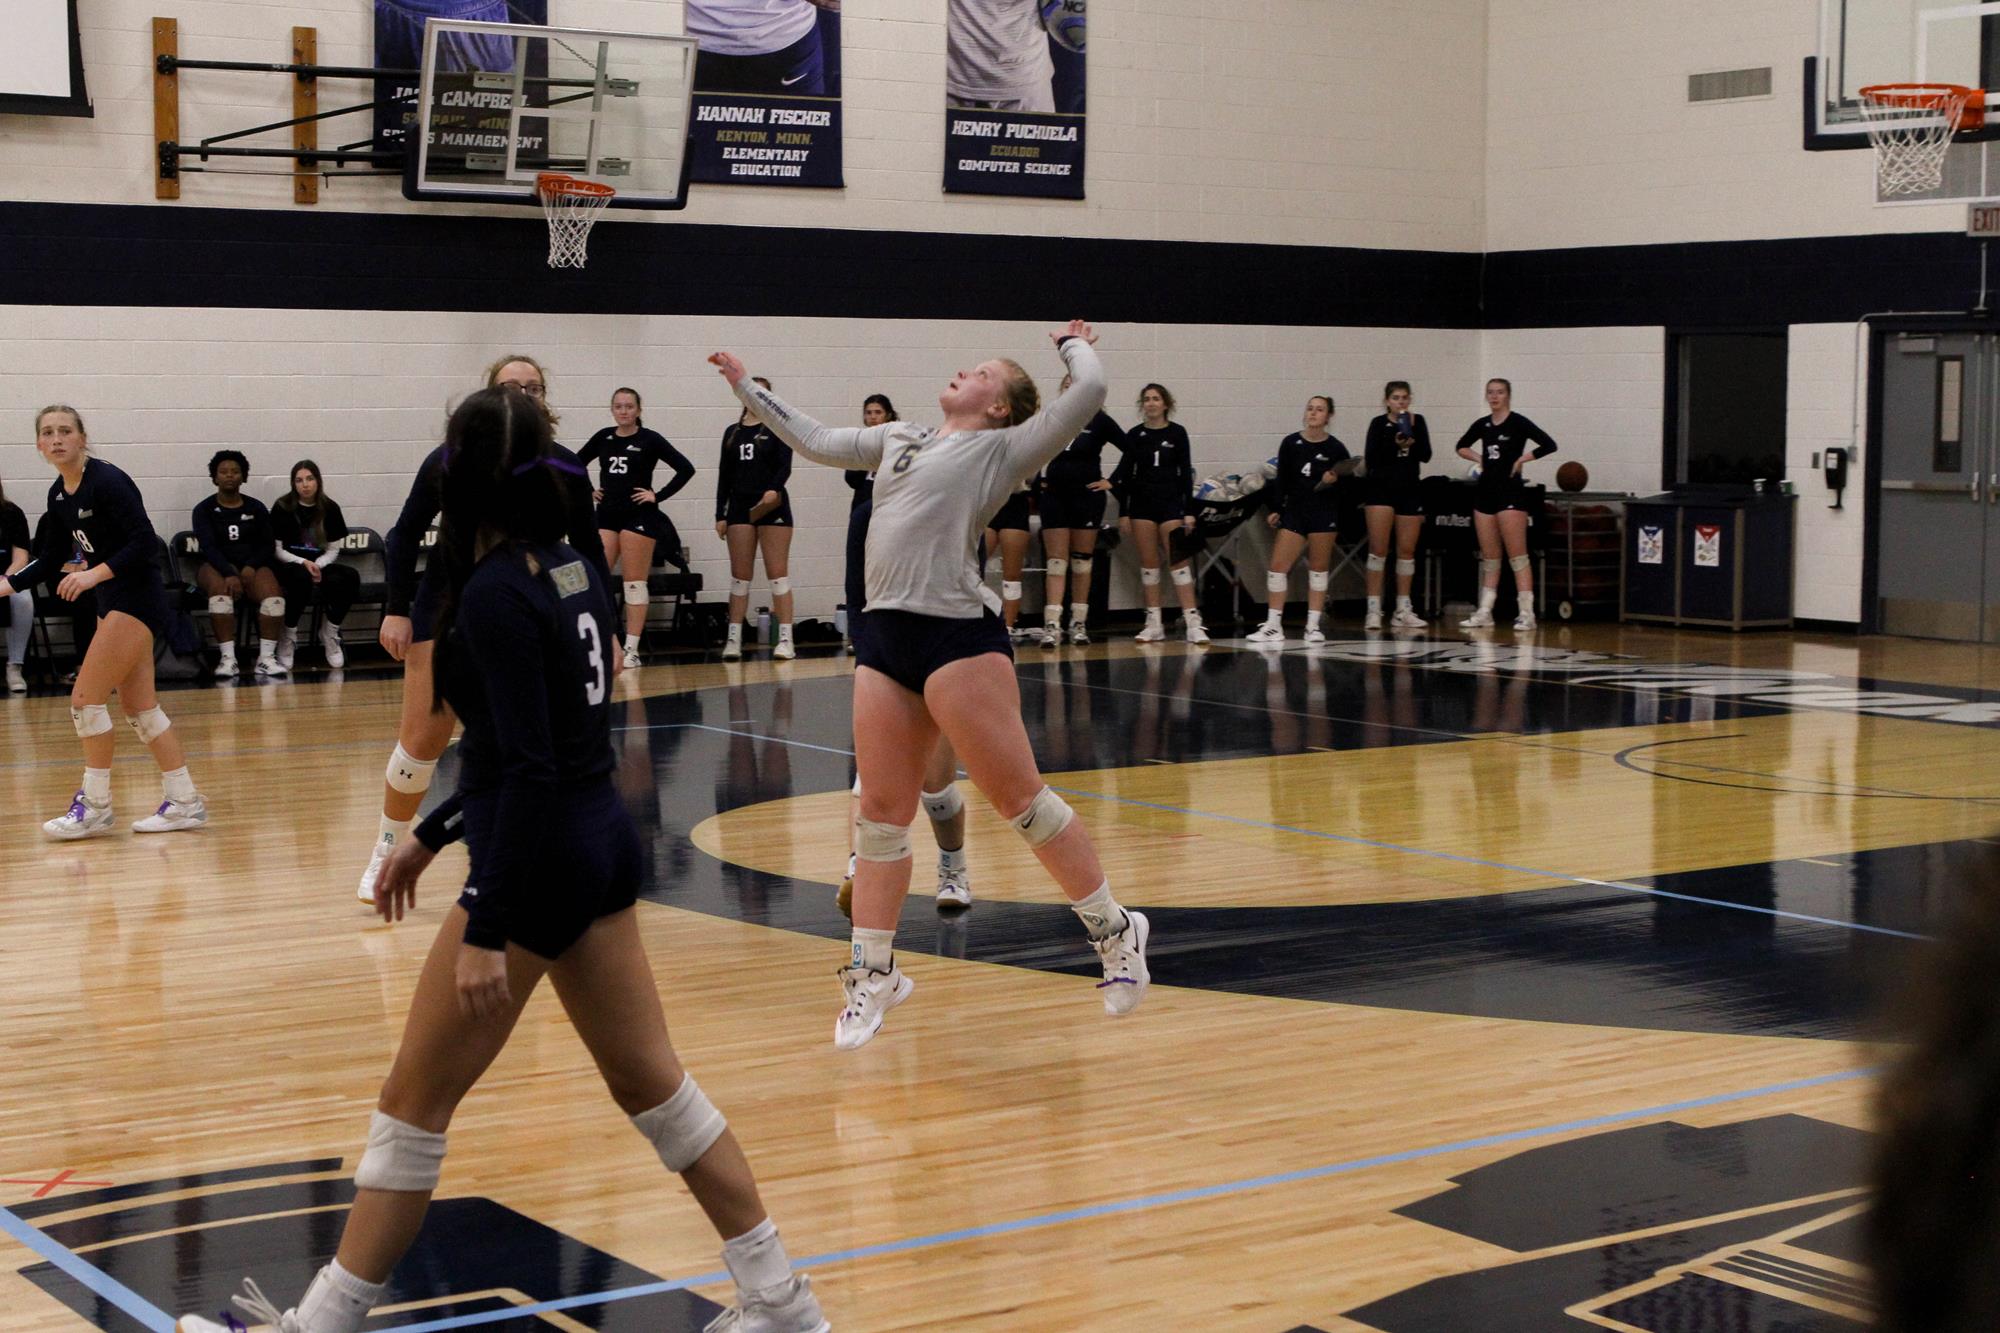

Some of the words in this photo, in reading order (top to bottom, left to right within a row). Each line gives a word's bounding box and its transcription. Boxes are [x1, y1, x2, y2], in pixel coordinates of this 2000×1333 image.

[697, 105, 765, 124] HANNAH
[768, 108, 831, 127] FISCHER
[775, 132, 813, 145] MINN.
[951, 120, 1002, 138] HENRY
[1004, 123, 1078, 142] PUCHUELA
[722, 147, 810, 162] ELEMENTARY
[990, 144, 1041, 158] ECUADOR
[730, 163, 802, 177] EDUCATION
[958, 159, 1020, 174] COMPUTER
[1024, 162, 1072, 176] SCIENCE
[739, 443, 755, 461] 13
[892, 444, 923, 475] 6
[1152, 450, 1161, 467] 1
[608, 456, 629, 475] 25
[1300, 461, 1313, 477] 4
[227, 524, 240, 541] 8
[340, 533, 370, 549] CU
[576, 611, 606, 706] 3
